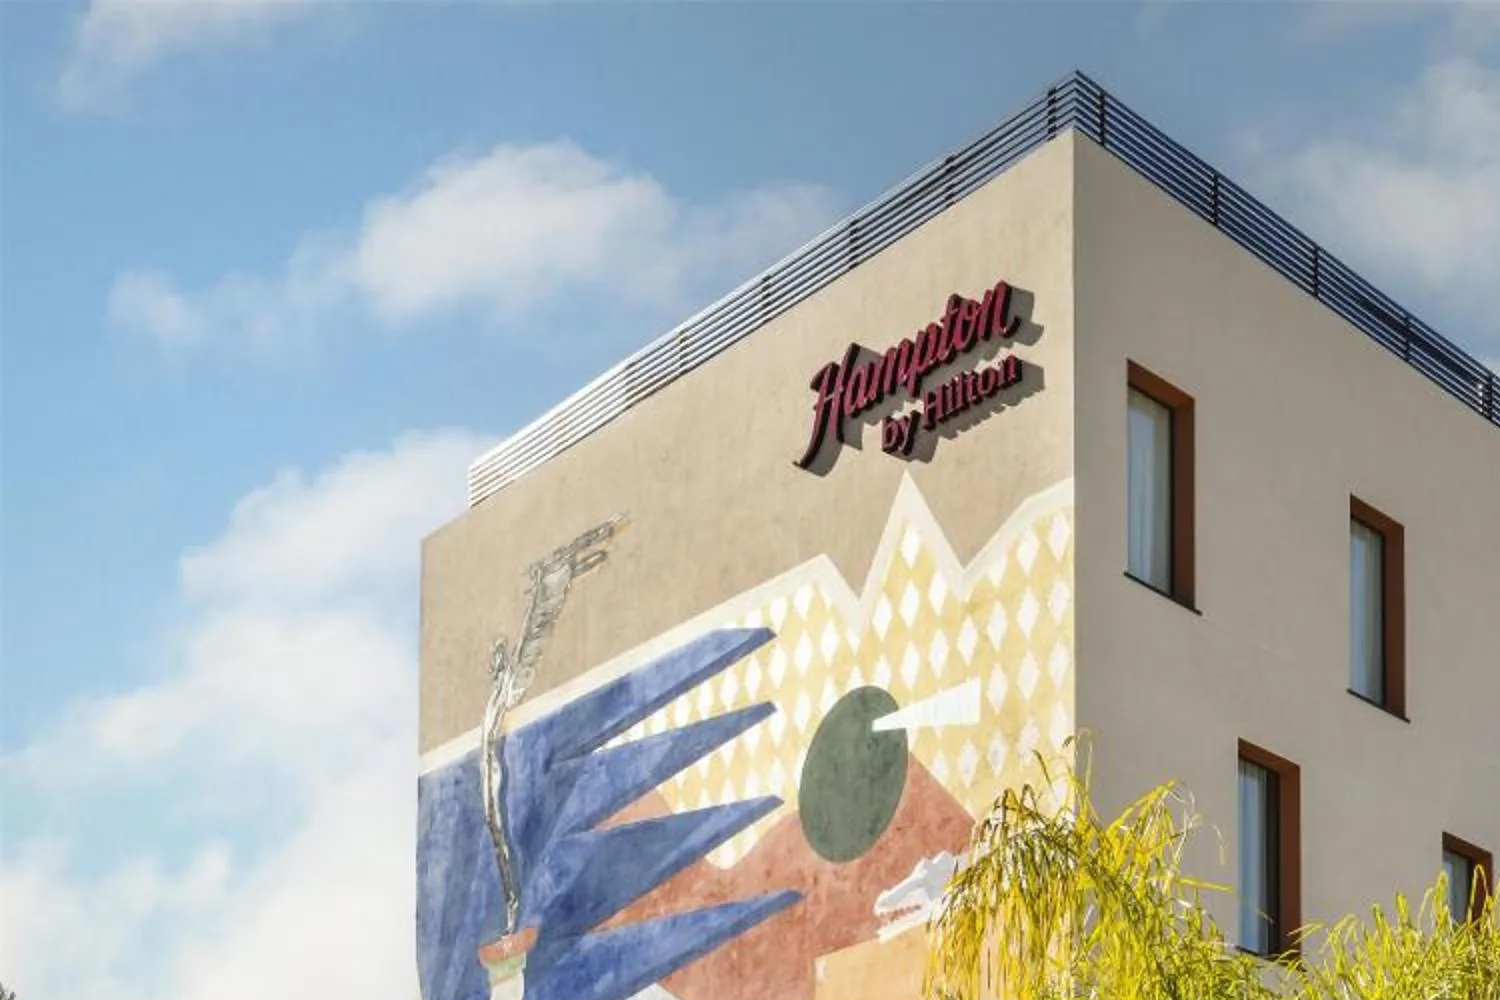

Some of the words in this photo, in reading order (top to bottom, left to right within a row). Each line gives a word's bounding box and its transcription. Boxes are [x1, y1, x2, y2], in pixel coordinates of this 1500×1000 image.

[793, 279, 1022, 469] Hampton
[881, 410, 921, 455] by
[922, 353, 1024, 430] Hilton
